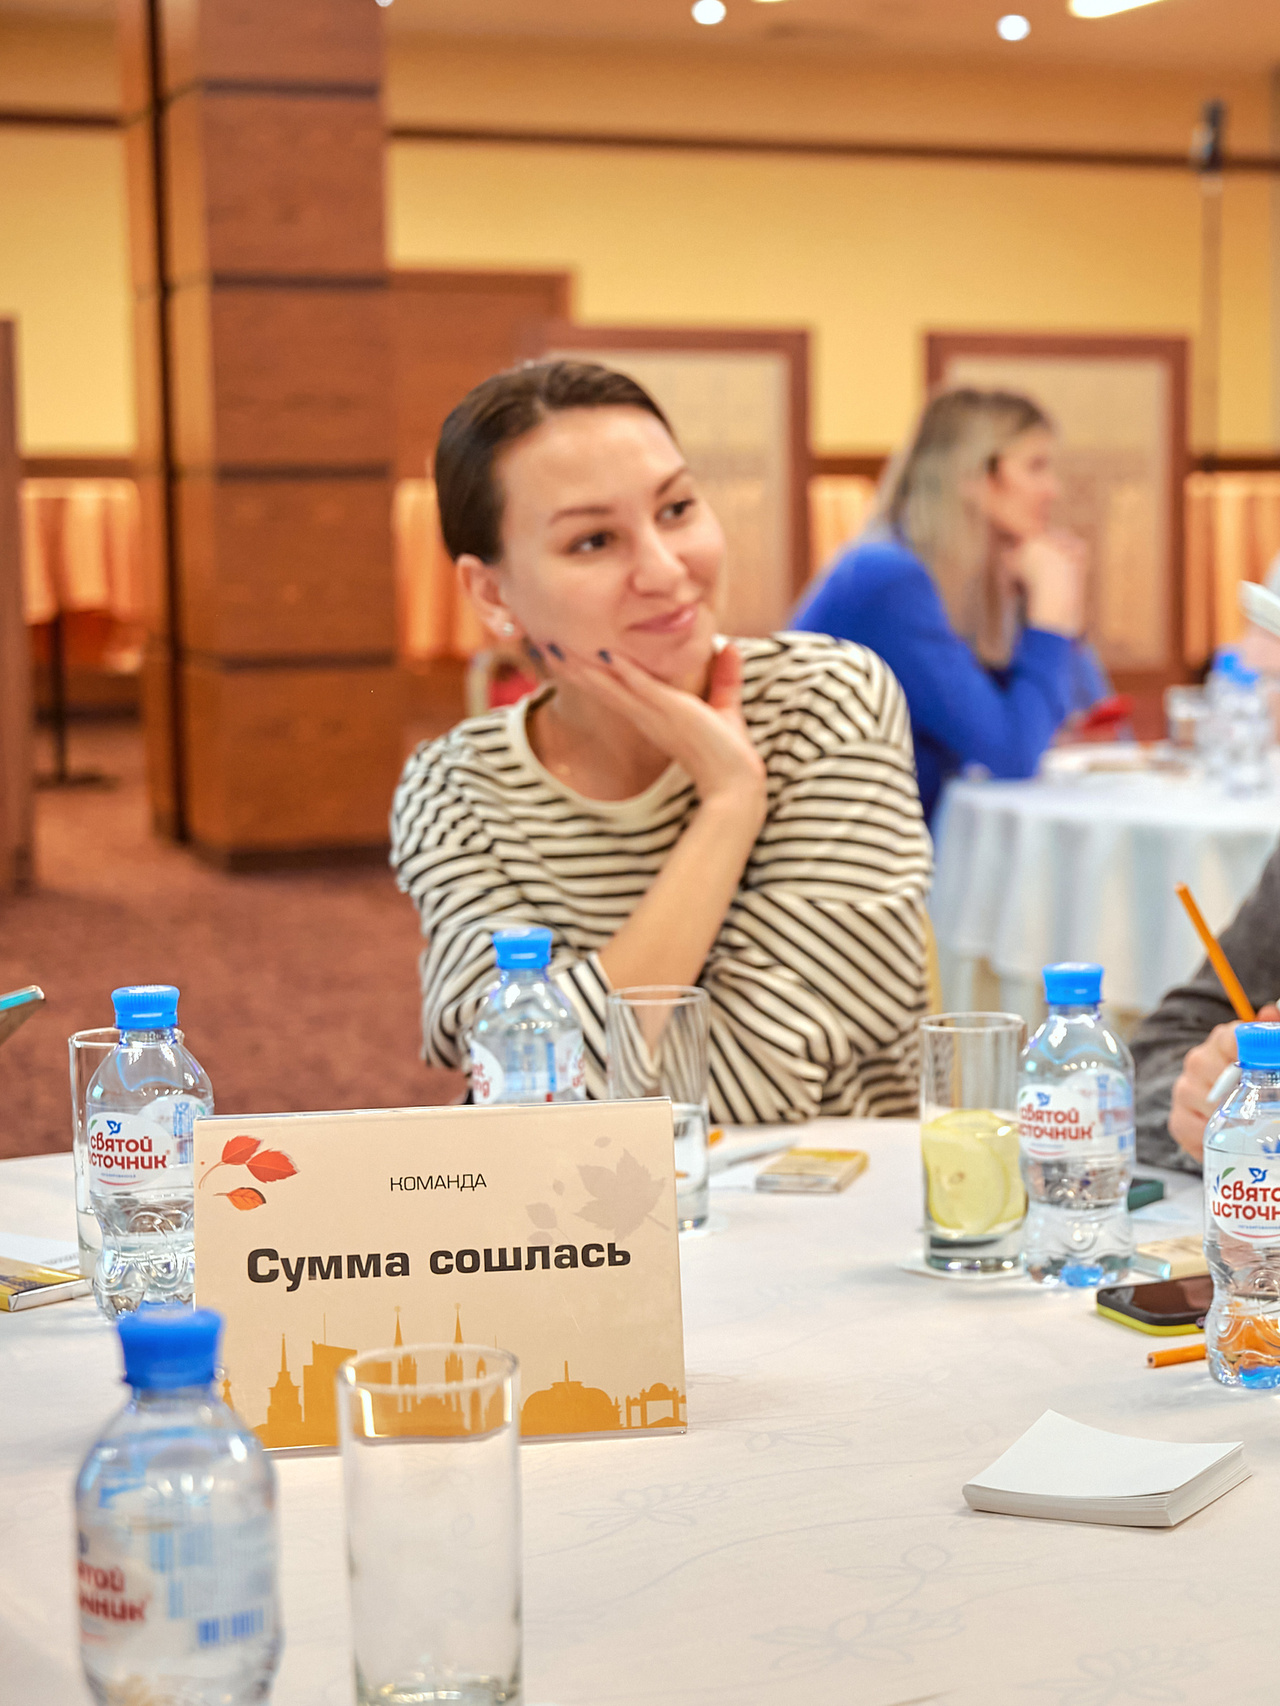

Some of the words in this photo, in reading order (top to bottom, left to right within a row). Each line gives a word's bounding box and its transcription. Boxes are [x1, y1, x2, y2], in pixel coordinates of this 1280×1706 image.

[1017, 1123, 1093, 1140] сточник
[90, 1153, 167, 1170] сточник
[390, 1173, 487, 1192] КОМАНДА
[247, 1247, 410, 1292] Сумма
[429, 1242, 632, 1275] сошлась
